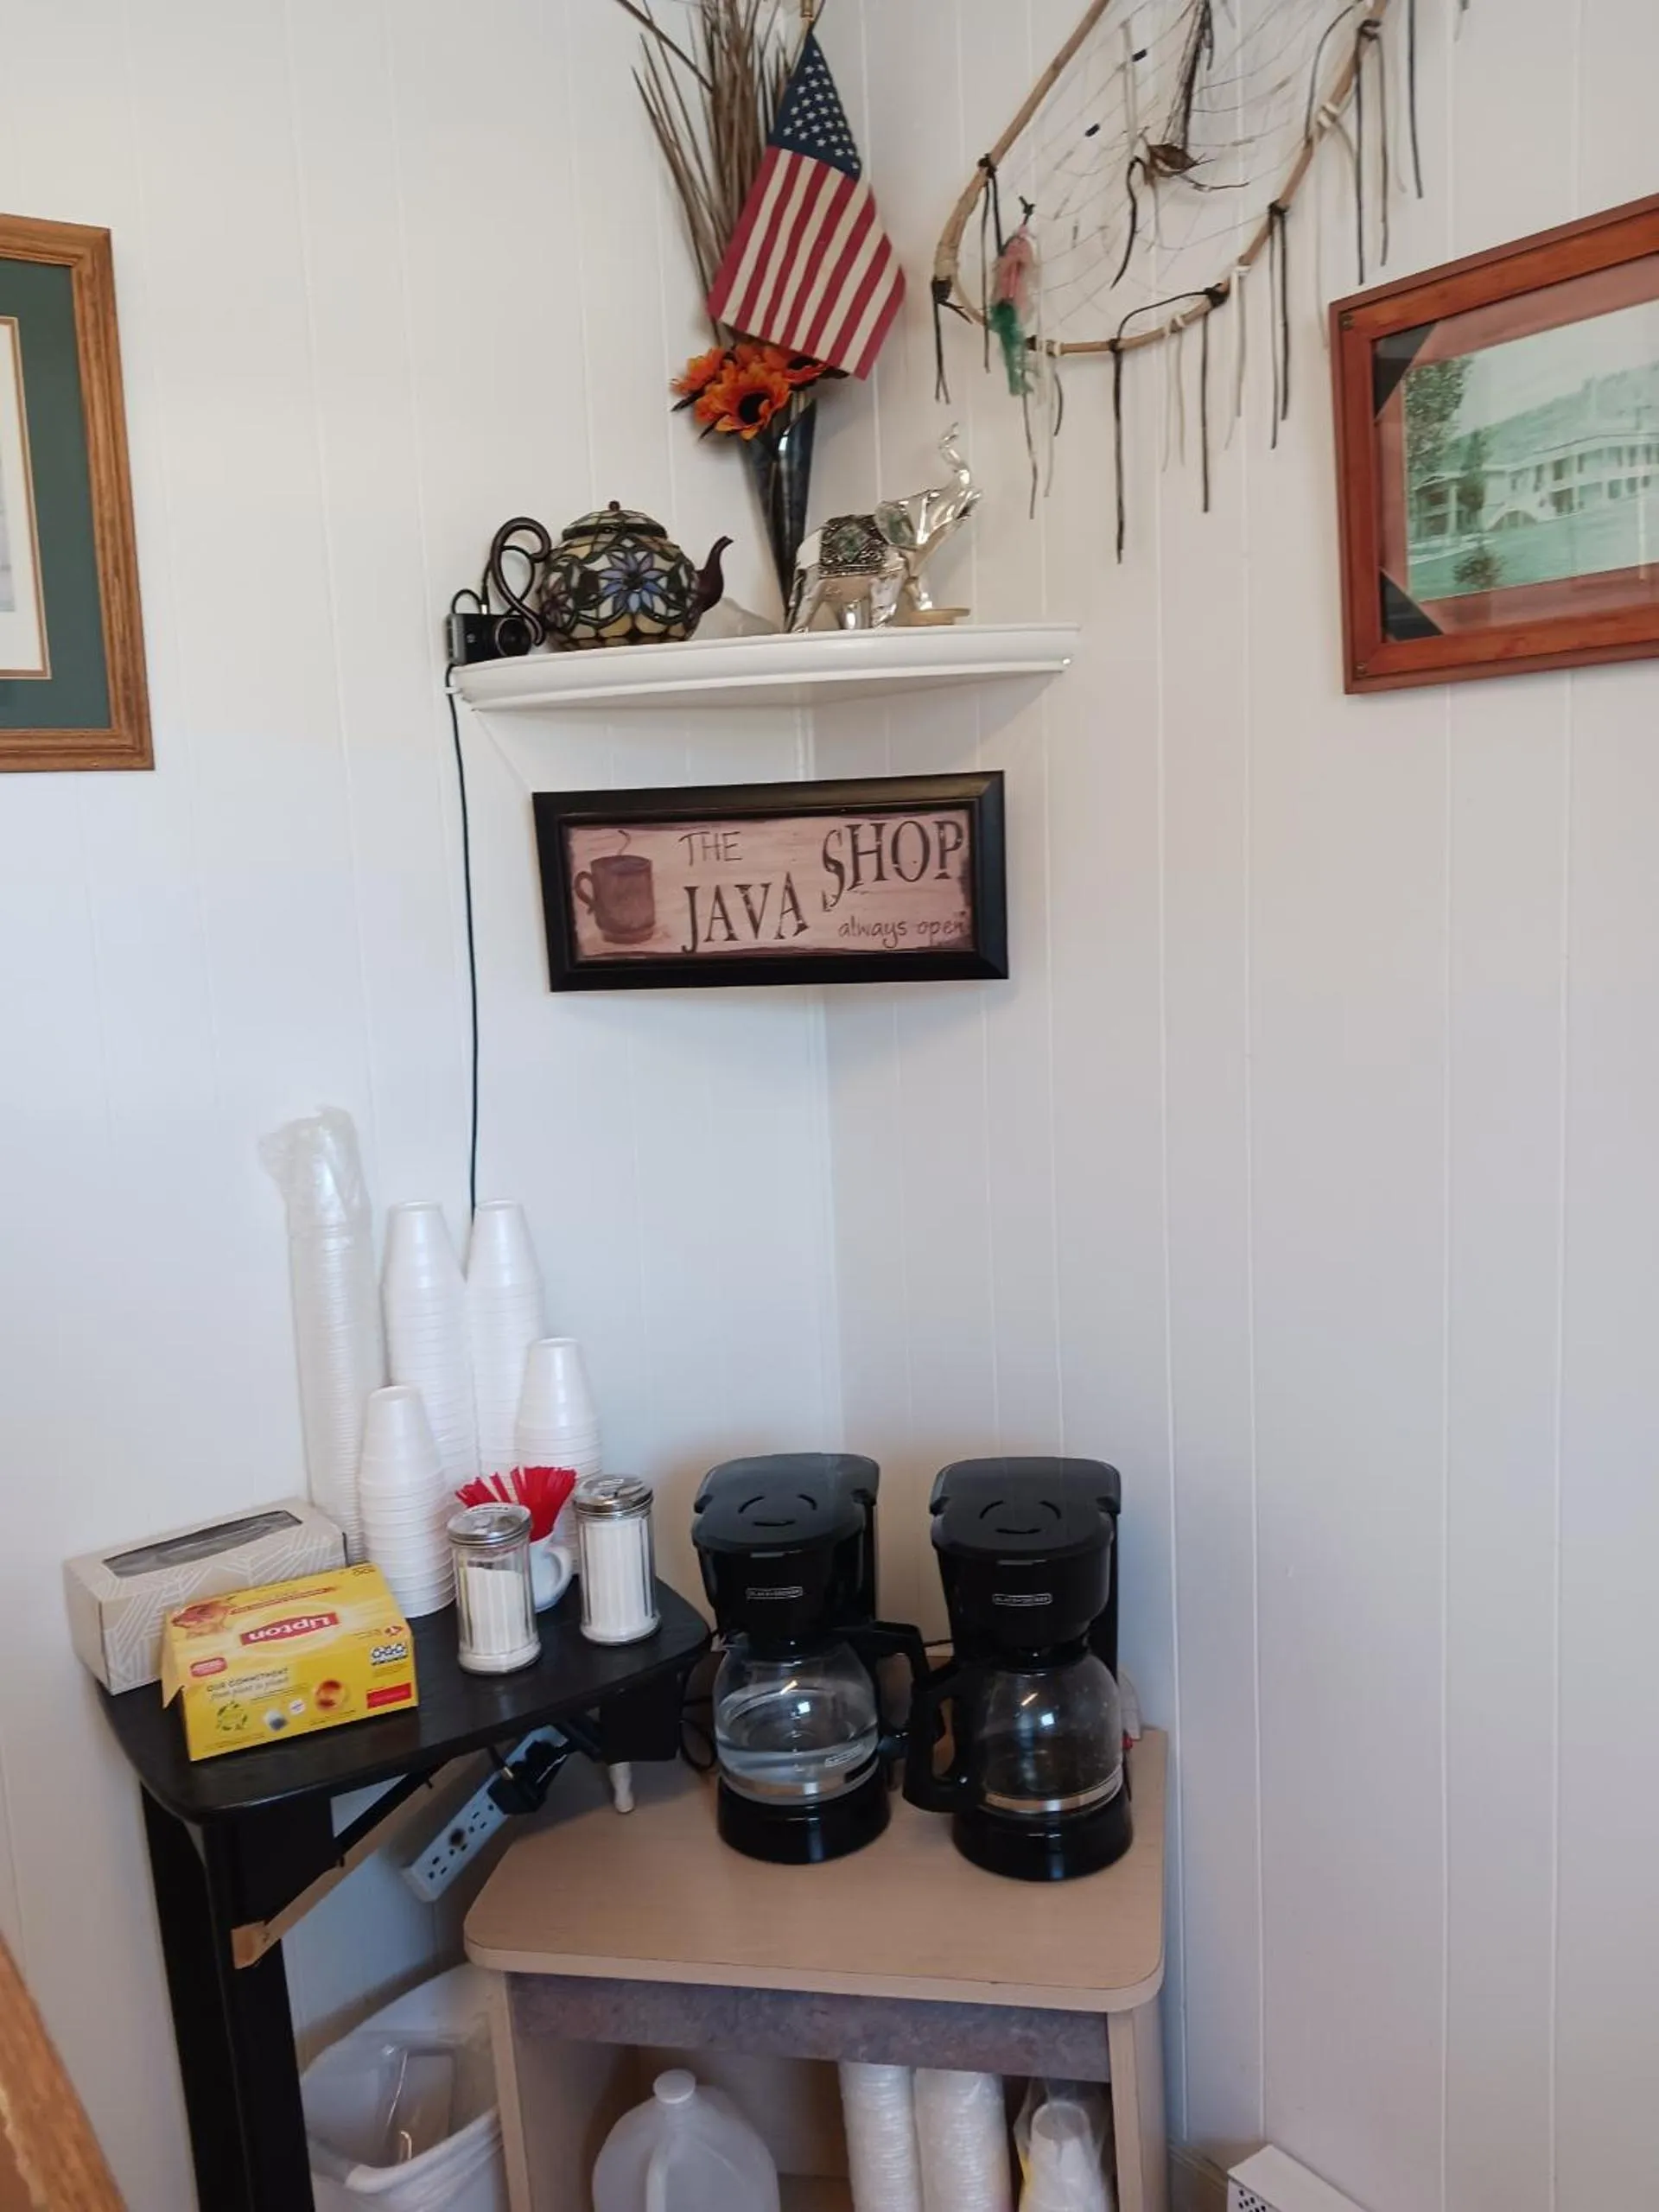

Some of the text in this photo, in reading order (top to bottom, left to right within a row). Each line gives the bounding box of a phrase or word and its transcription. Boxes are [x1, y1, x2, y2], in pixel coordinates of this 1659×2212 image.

[678, 830, 743, 867] THE
[681, 820, 964, 955] JAVA SHOP
[838, 914, 965, 949] always open
[247, 1616, 331, 1641] Lipton
